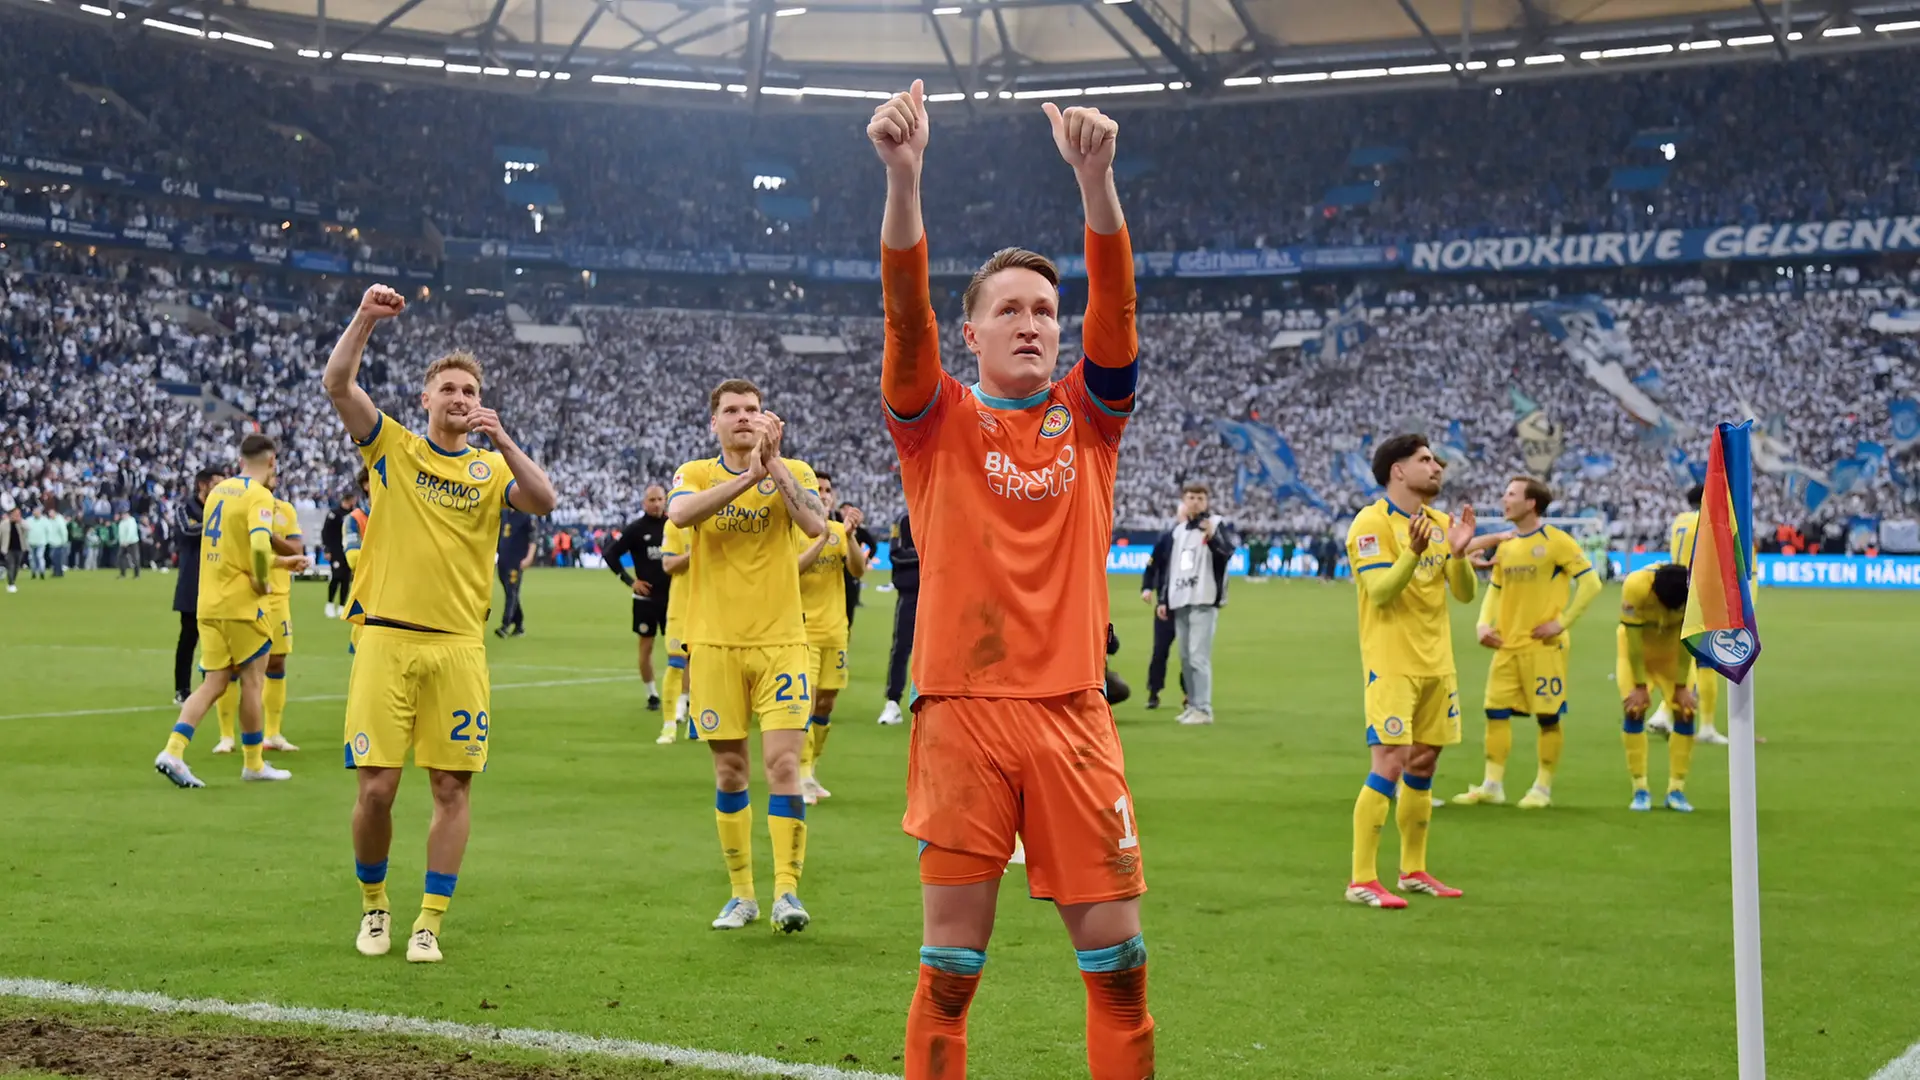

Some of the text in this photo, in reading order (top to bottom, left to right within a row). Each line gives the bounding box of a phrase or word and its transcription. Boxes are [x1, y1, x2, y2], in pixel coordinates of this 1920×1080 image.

[1412, 215, 1920, 271] NORDKURVE GELSENK
[416, 471, 480, 501] BRAWO
[987, 467, 1076, 500] GROUP
[416, 486, 480, 512] GROUP
[205, 499, 224, 547] 4
[715, 517, 770, 534] GROUP
[1772, 560, 1858, 583] BESTEN
[775, 672, 810, 702] 21
[1535, 676, 1562, 696] 20
[450, 709, 489, 742] 29
[1114, 794, 1137, 849] 1
